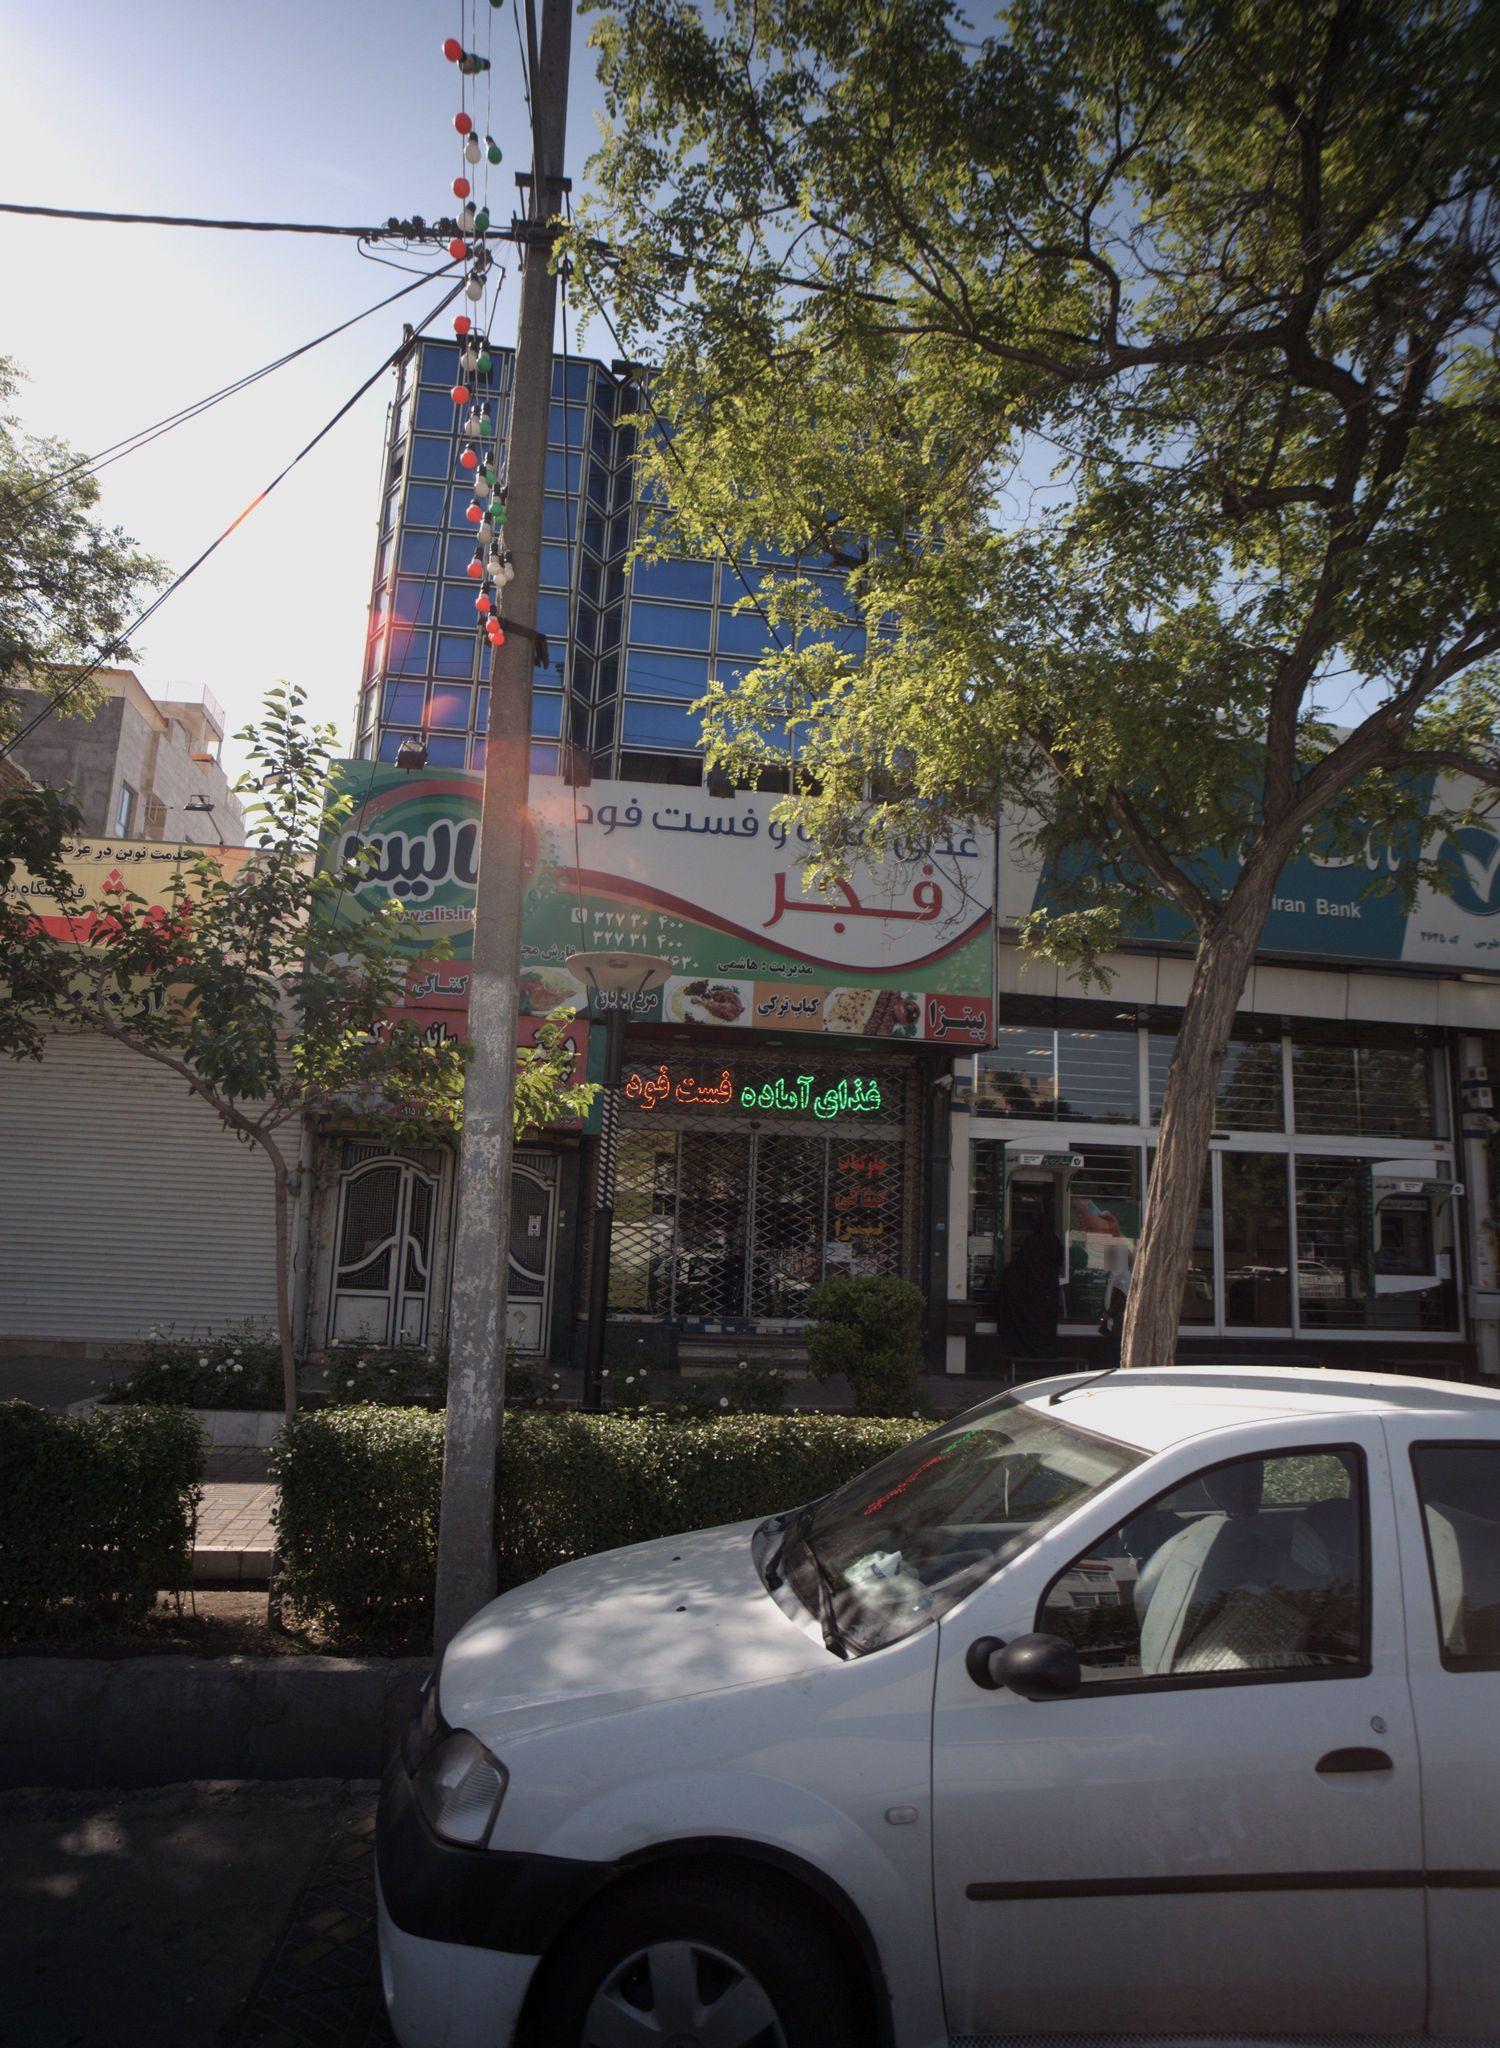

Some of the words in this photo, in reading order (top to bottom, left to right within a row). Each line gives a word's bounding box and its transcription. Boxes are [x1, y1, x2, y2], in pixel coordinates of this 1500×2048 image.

[575, 797, 643, 836] فود
[652, 807, 759, 838] فست
[94, 846, 112, 860] در
[115, 846, 147, 863] نوین
[761, 862, 943, 934] فجر
[1316, 898, 1362, 919] Bank
[593, 911, 625, 927] ۳۲۷
[658, 915, 685, 931] ۴۰۰
[592, 930, 625, 947] ۳۲۷
[656, 934, 683, 949] ۴۰۰
[717, 957, 759, 974] هاشمی
[768, 960, 815, 978] مدیریت
[411, 973, 470, 999] کنتاکی
[757, 995, 791, 1018] ترکی
[789, 998, 819, 1016] کباب
[928, 999, 988, 1041] پیتزا
[625, 1064, 671, 1110] فود
[674, 1069, 733, 1105] فست
[740, 1074, 815, 1111] آماده
[813, 1077, 882, 1119] غذای
